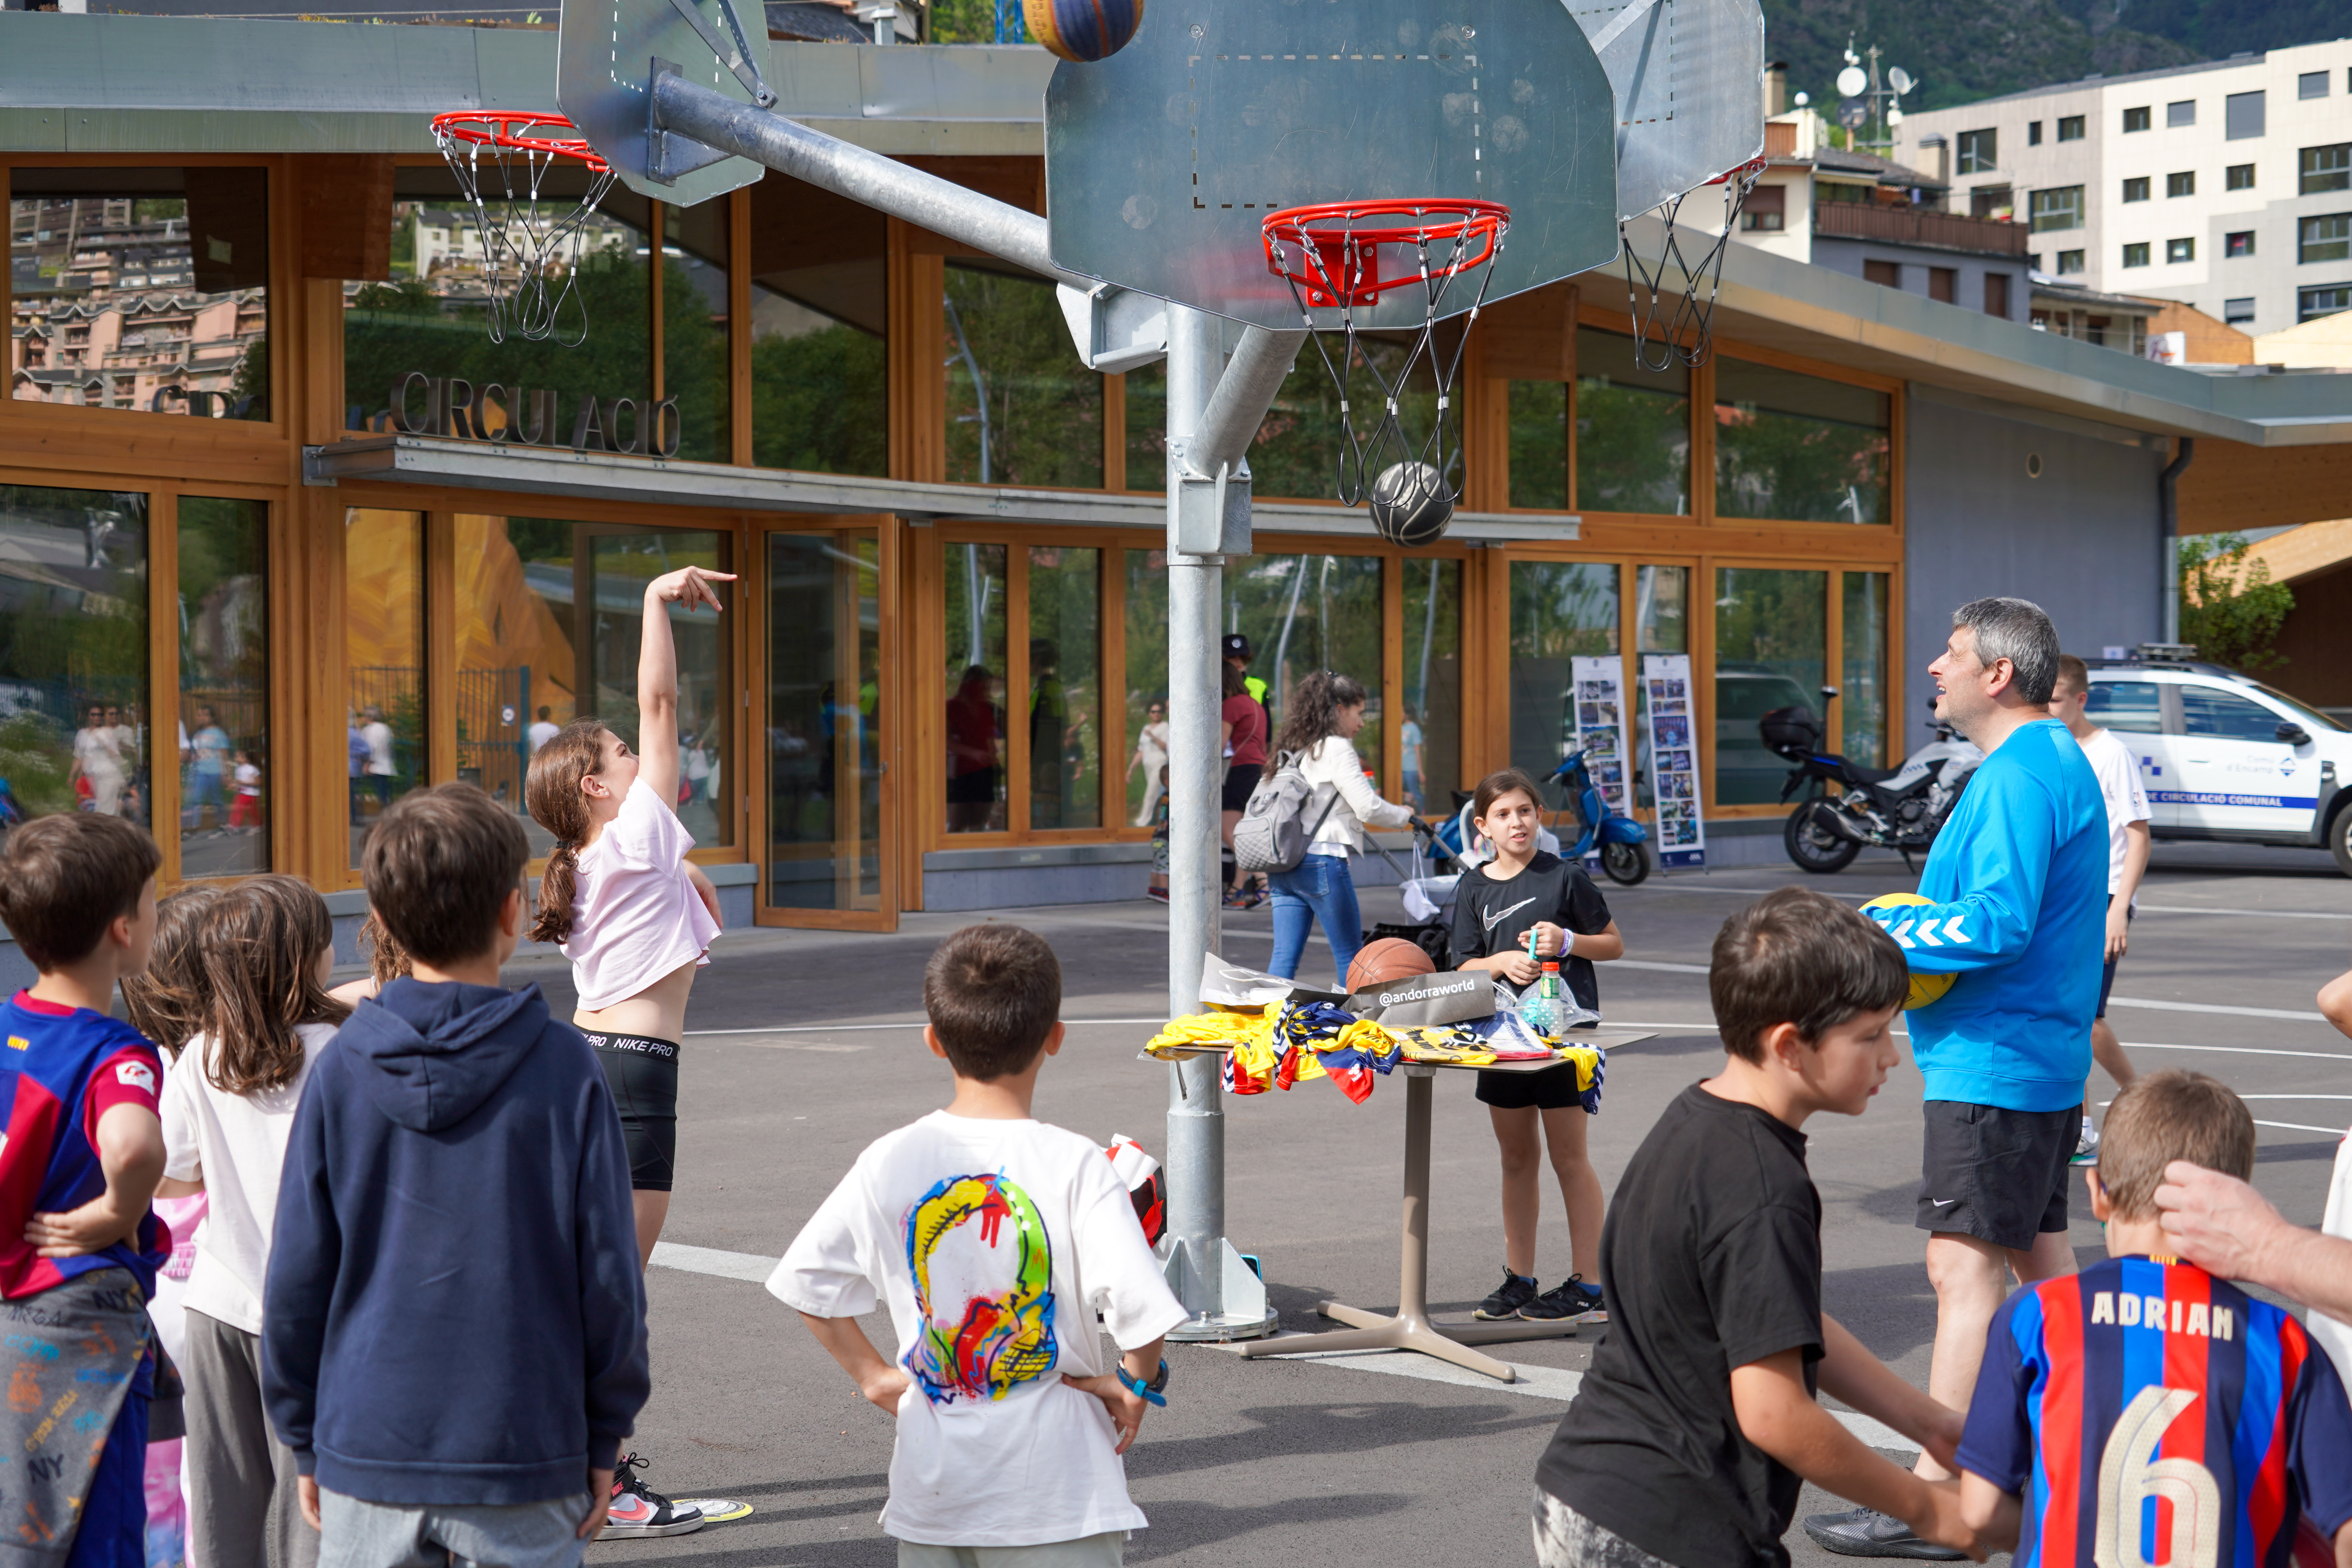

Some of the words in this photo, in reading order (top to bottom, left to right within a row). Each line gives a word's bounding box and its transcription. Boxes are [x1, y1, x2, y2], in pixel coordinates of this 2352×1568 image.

[391, 371, 681, 458] CIRCULACIÓ
[2229, 795, 2283, 807] COMUNAL
[1379, 979, 1475, 1007] @andorraworld
[587, 1035, 607, 1047] PRO
[613, 1038, 650, 1051] NIKE
[648, 1043, 673, 1057] PRO
[2091, 1291, 2233, 1342] ADRIAN
[28, 1454, 64, 1485] NY
[2093, 1385, 2222, 1568] 6
[611, 1481, 624, 1497] NIKE
